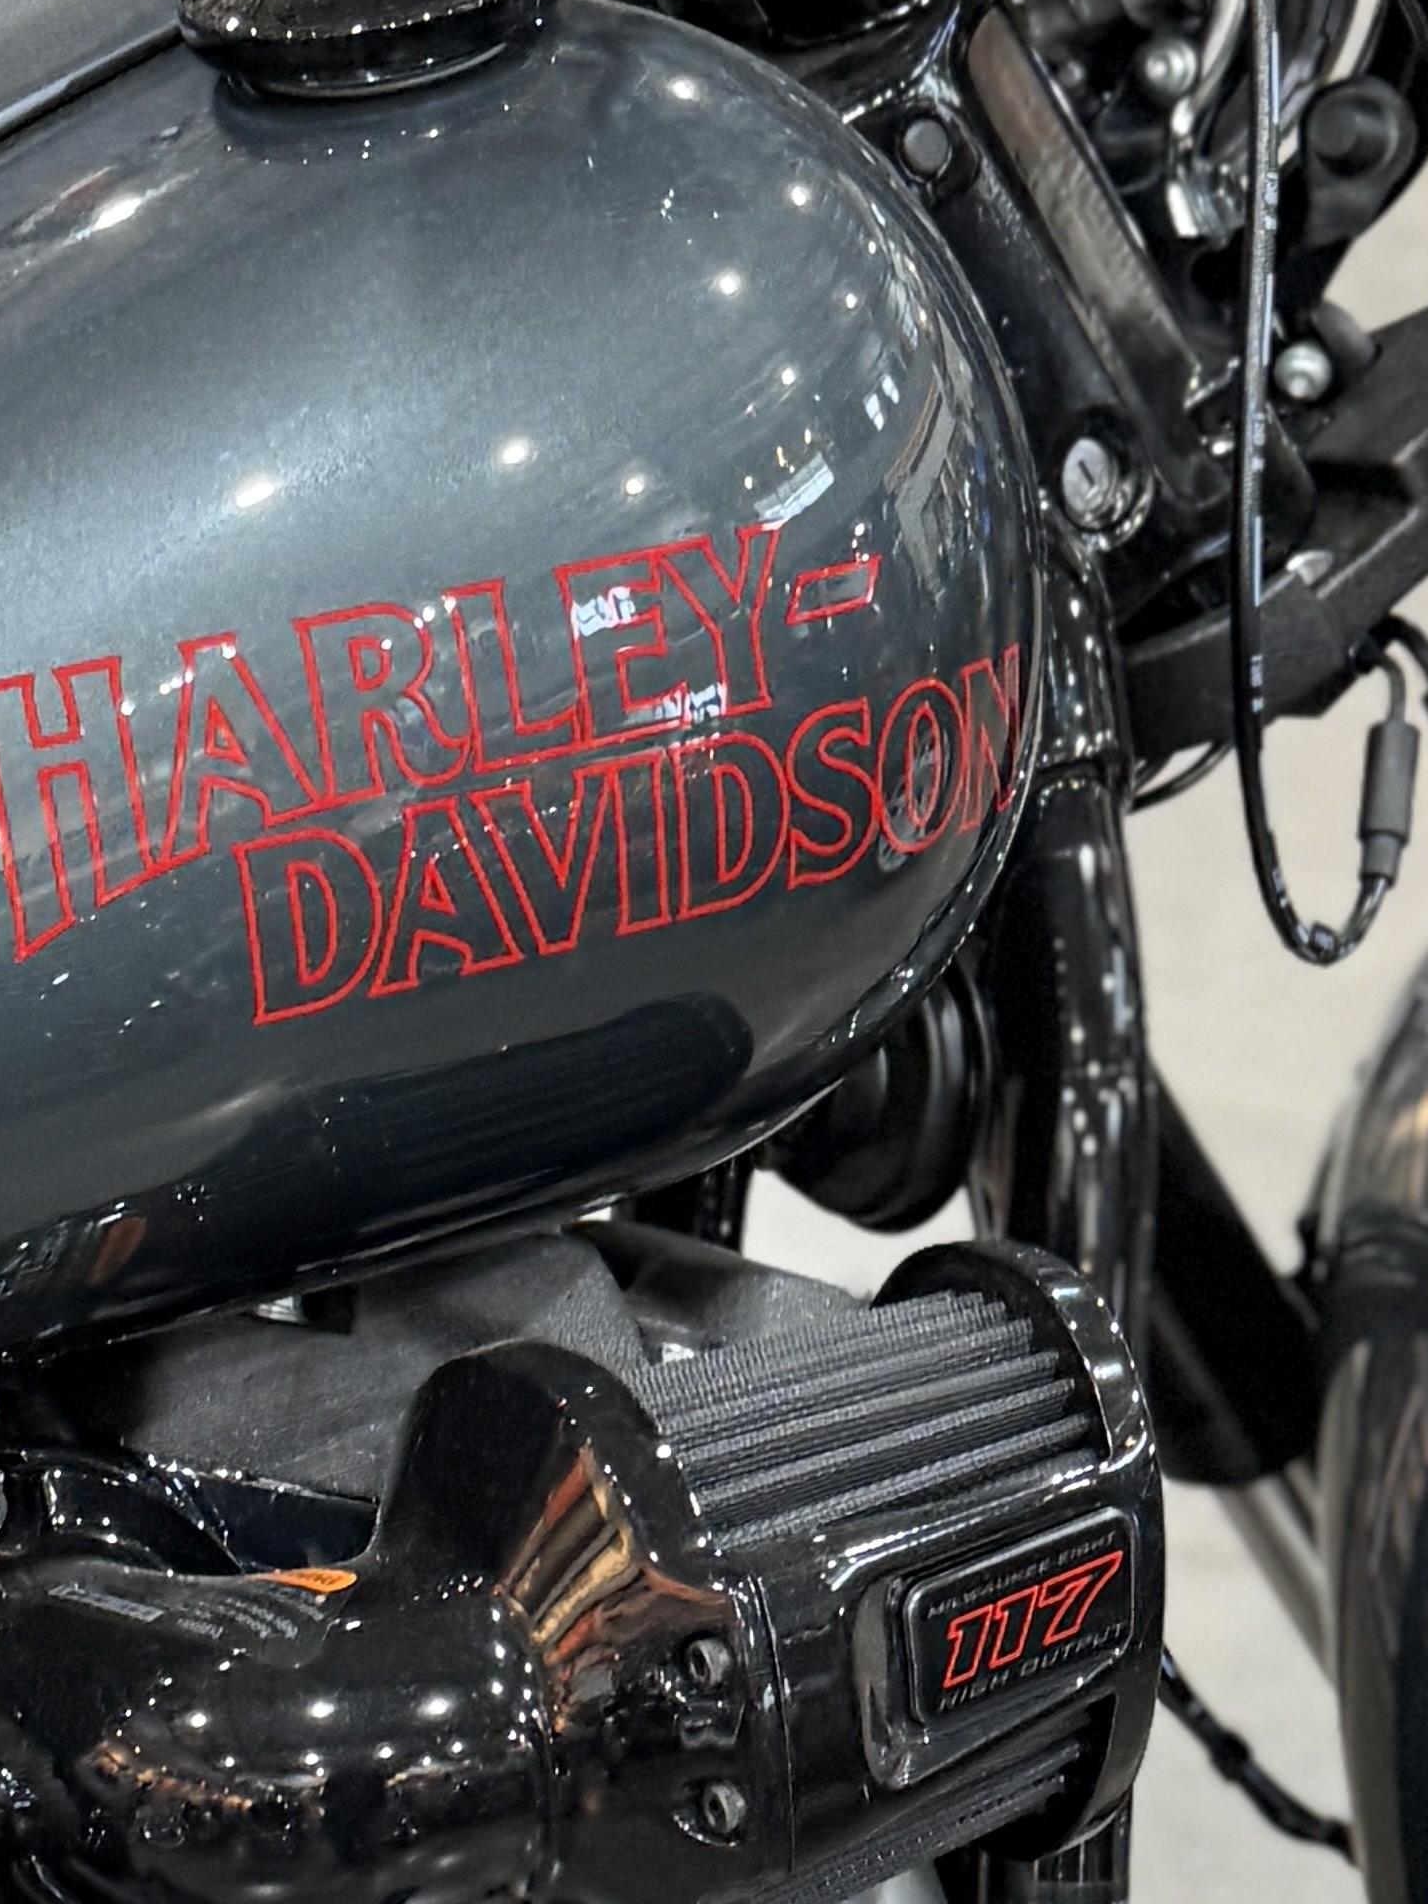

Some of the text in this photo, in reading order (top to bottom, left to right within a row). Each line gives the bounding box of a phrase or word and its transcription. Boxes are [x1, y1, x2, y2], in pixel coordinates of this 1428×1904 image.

[231, 643, 1019, 1025] DAVIDSON
[938, 1624, 1122, 1711] HIGH OUTPUT
[942, 1550, 1123, 1692] 117
